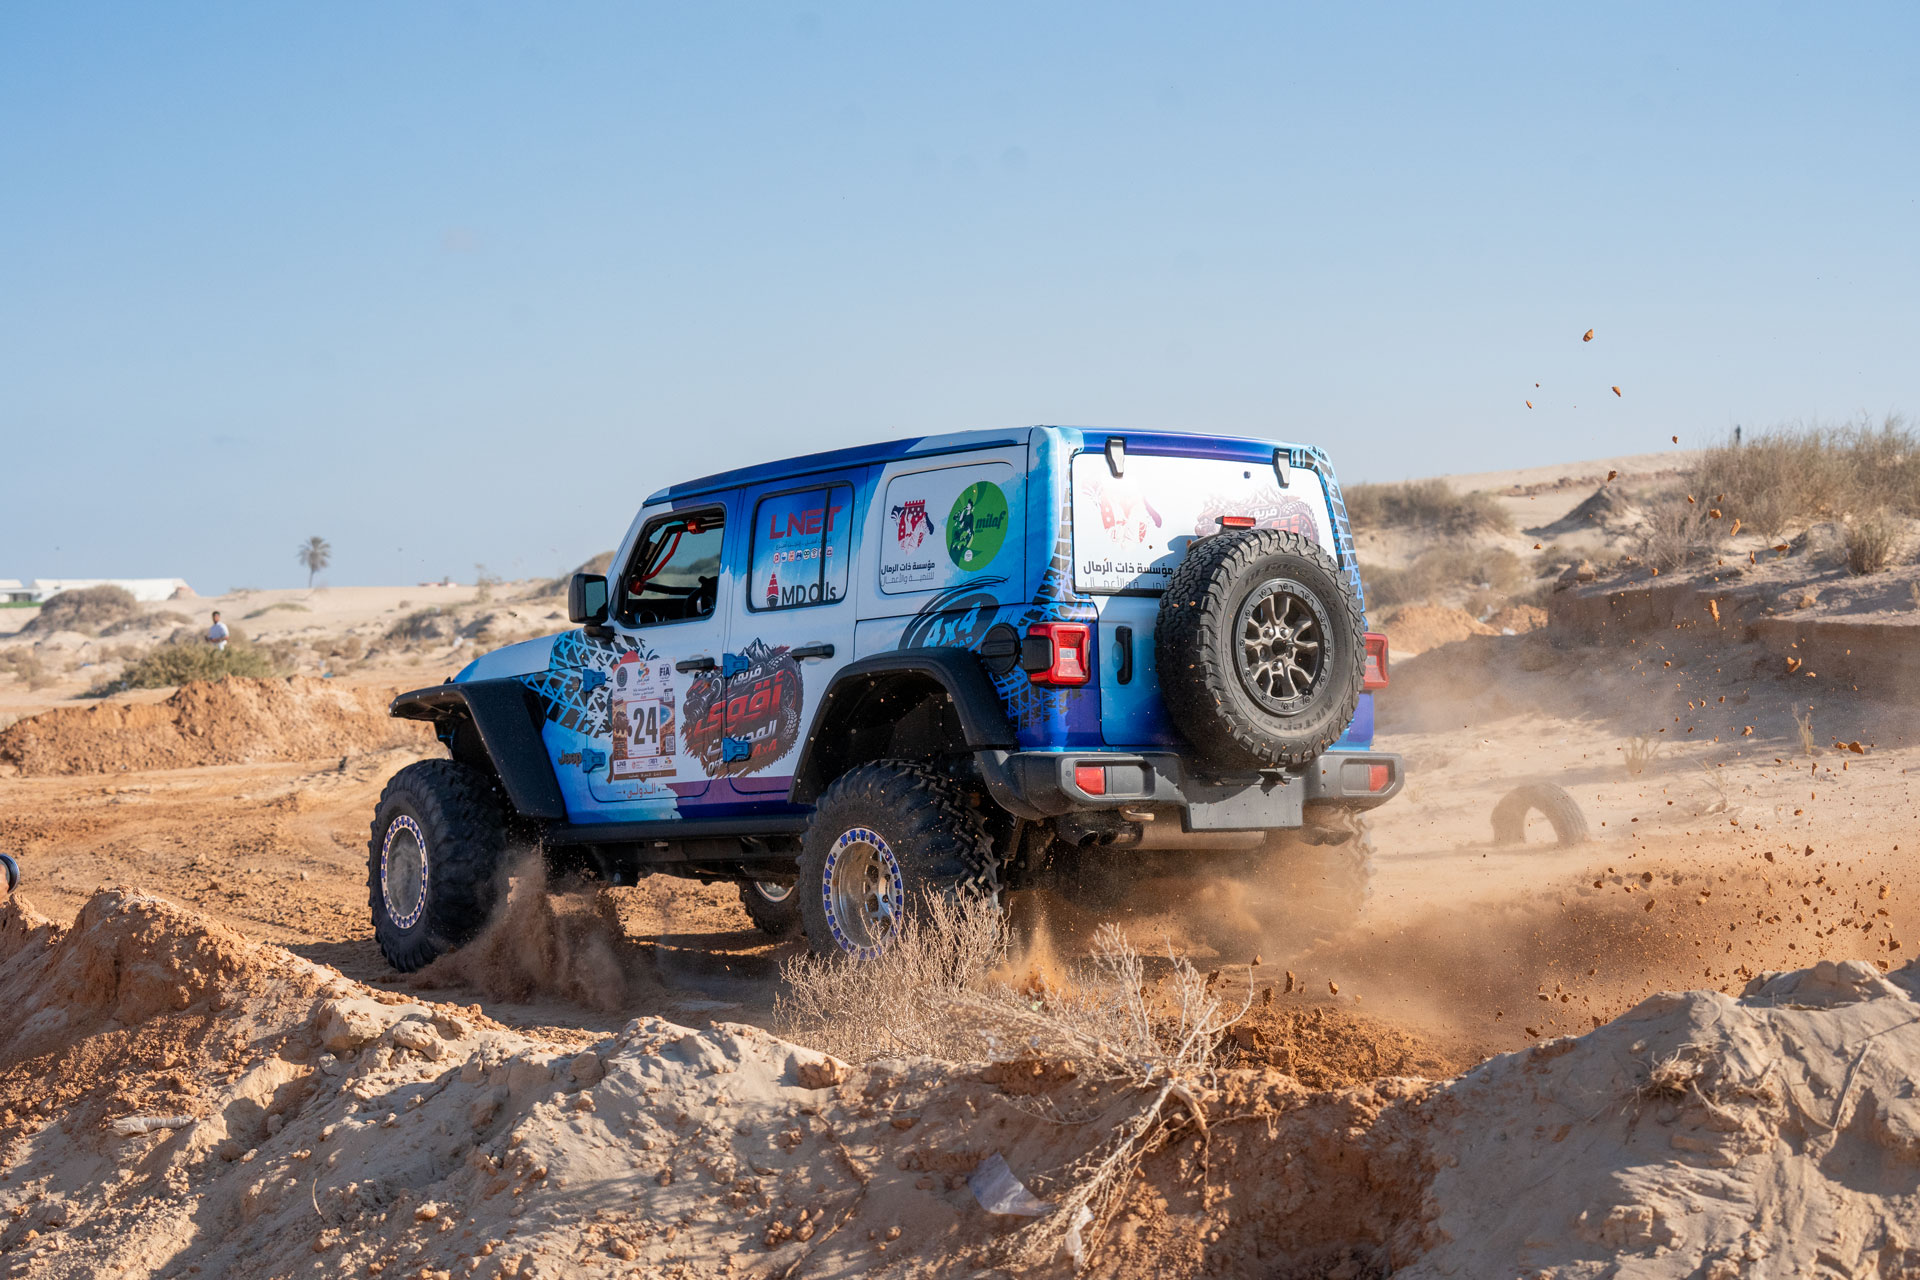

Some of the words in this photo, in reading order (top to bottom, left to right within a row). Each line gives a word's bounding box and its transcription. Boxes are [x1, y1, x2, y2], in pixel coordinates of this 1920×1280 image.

[769, 505, 843, 540] LNET
[975, 510, 1007, 530] milaf
[880, 563, 900, 576] الرمال
[899, 562, 912, 572] ذات
[912, 560, 936, 573] مؤسسة
[1083, 560, 1113, 575] الرمال
[1115, 562, 1135, 574] ذات
[1137, 562, 1174, 578] مؤسسة
[781, 581, 837, 606] MDOls
[950, 635, 973, 648] OAD
[659, 666, 671, 677] FIA
[633, 706, 658, 745] 24
[558, 749, 583, 767] Jeep
